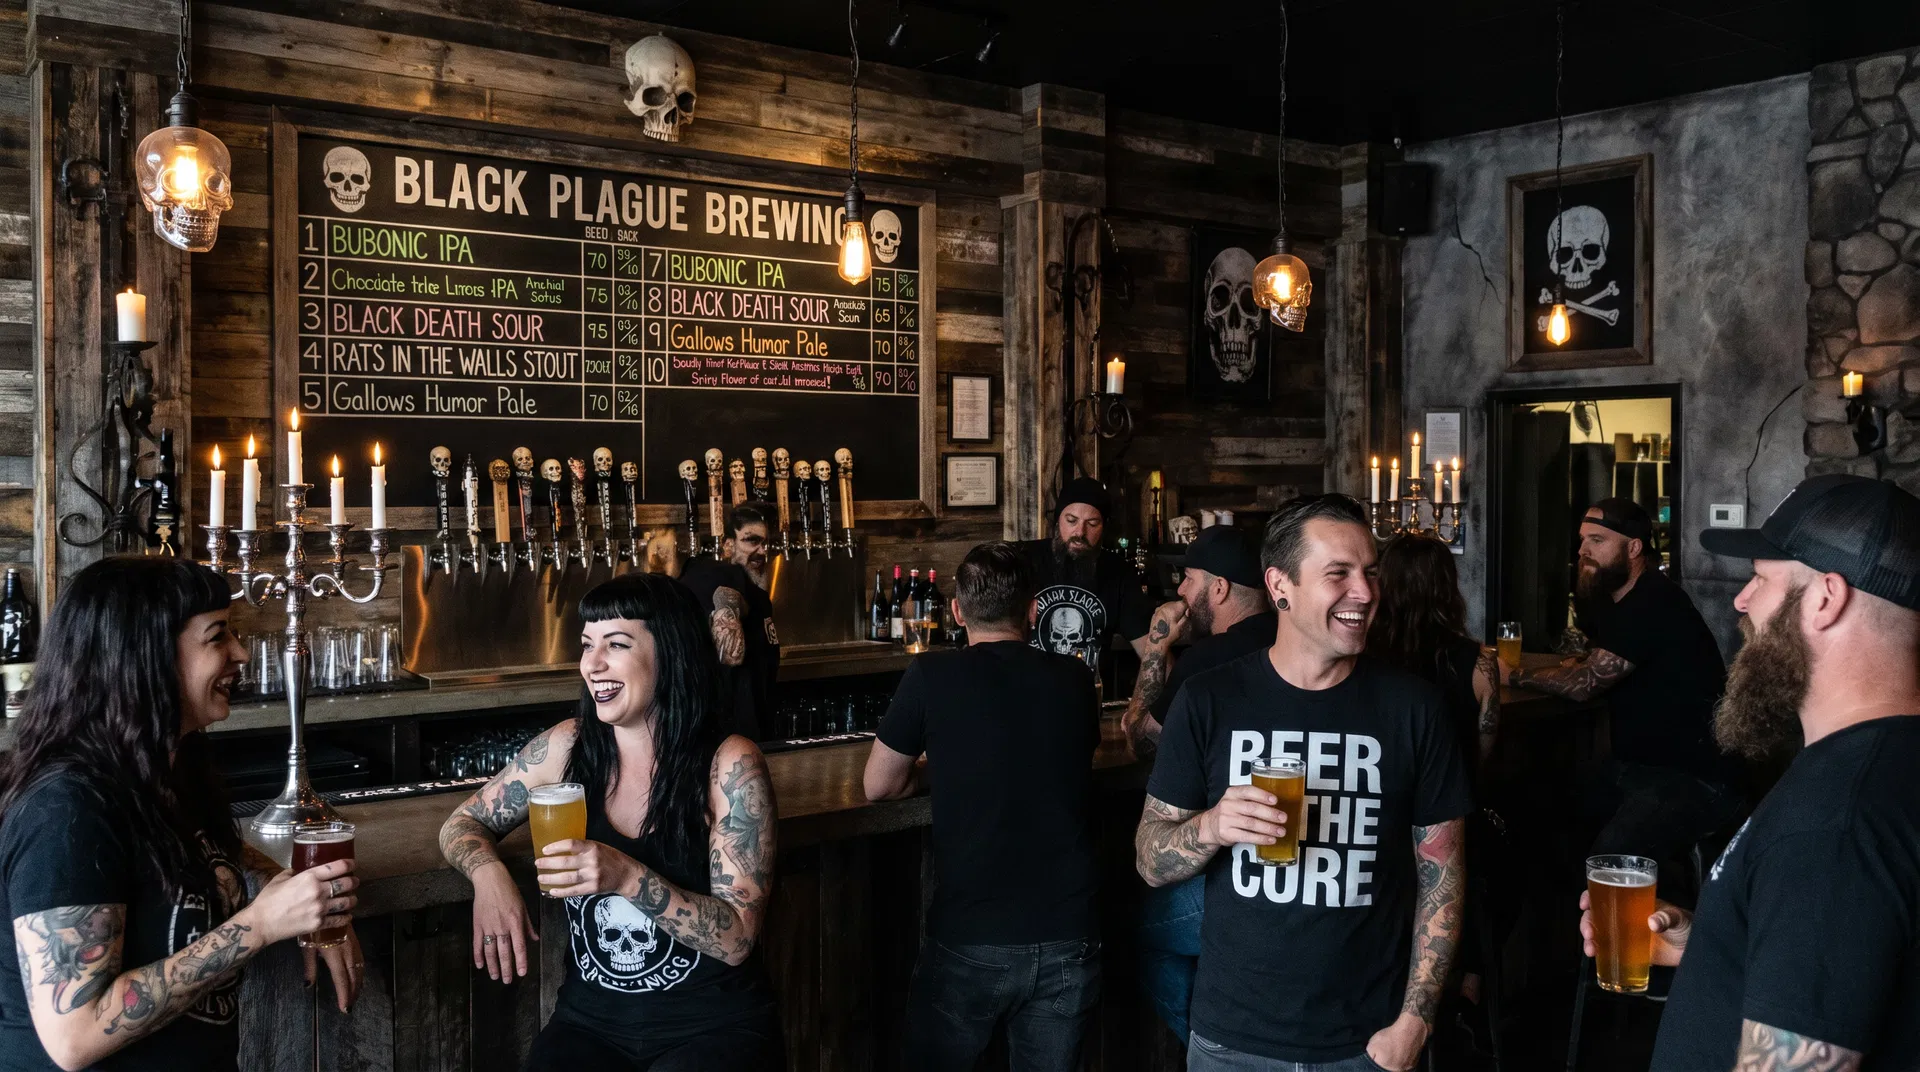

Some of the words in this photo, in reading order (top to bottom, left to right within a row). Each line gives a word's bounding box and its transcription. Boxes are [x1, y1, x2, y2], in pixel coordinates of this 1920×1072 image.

[394, 155, 529, 216] BLACK
[549, 173, 688, 231] PLAGUE
[304, 222, 319, 251] 1
[332, 225, 428, 260] BUBONIC
[439, 234, 474, 264] IPA
[587, 252, 607, 269] 70
[617, 229, 639, 242] SACK
[303, 262, 321, 290] 2
[648, 253, 662, 278] 7
[670, 254, 747, 286] BUBONIC
[757, 261, 785, 288] IPA
[875, 277, 891, 292] 75
[586, 287, 608, 304] 75
[648, 287, 662, 313] 8
[670, 288, 726, 317] BLACK
[732, 292, 783, 320] DEATH
[789, 296, 830, 323] SOUR
[303, 302, 321, 331] 3
[332, 303, 405, 335] BLACK
[414, 308, 482, 339] DEATH
[491, 313, 544, 342] SOUR
[588, 323, 608, 339] 95
[874, 308, 891, 323] 65
[649, 322, 661, 347] 9
[670, 323, 734, 351] Gallows
[741, 327, 790, 355] Humor
[796, 330, 829, 356] Pale
[875, 340, 891, 355] 70
[303, 342, 322, 370] 4
[332, 343, 385, 373] RATS
[392, 345, 412, 373] IN
[416, 345, 453, 375] THE
[459, 348, 518, 378] WALLS
[523, 350, 579, 379] STOUT
[648, 357, 666, 383] 10
[749, 374, 760, 385] of
[874, 371, 892, 386] 90
[303, 381, 321, 410] 5
[332, 381, 415, 413] Gallows
[425, 384, 487, 414] Humor
[497, 386, 538, 415] Pale
[589, 394, 609, 411] 70
[1229, 730, 1382, 794] BEER
[1231, 842, 1377, 907] CURE
